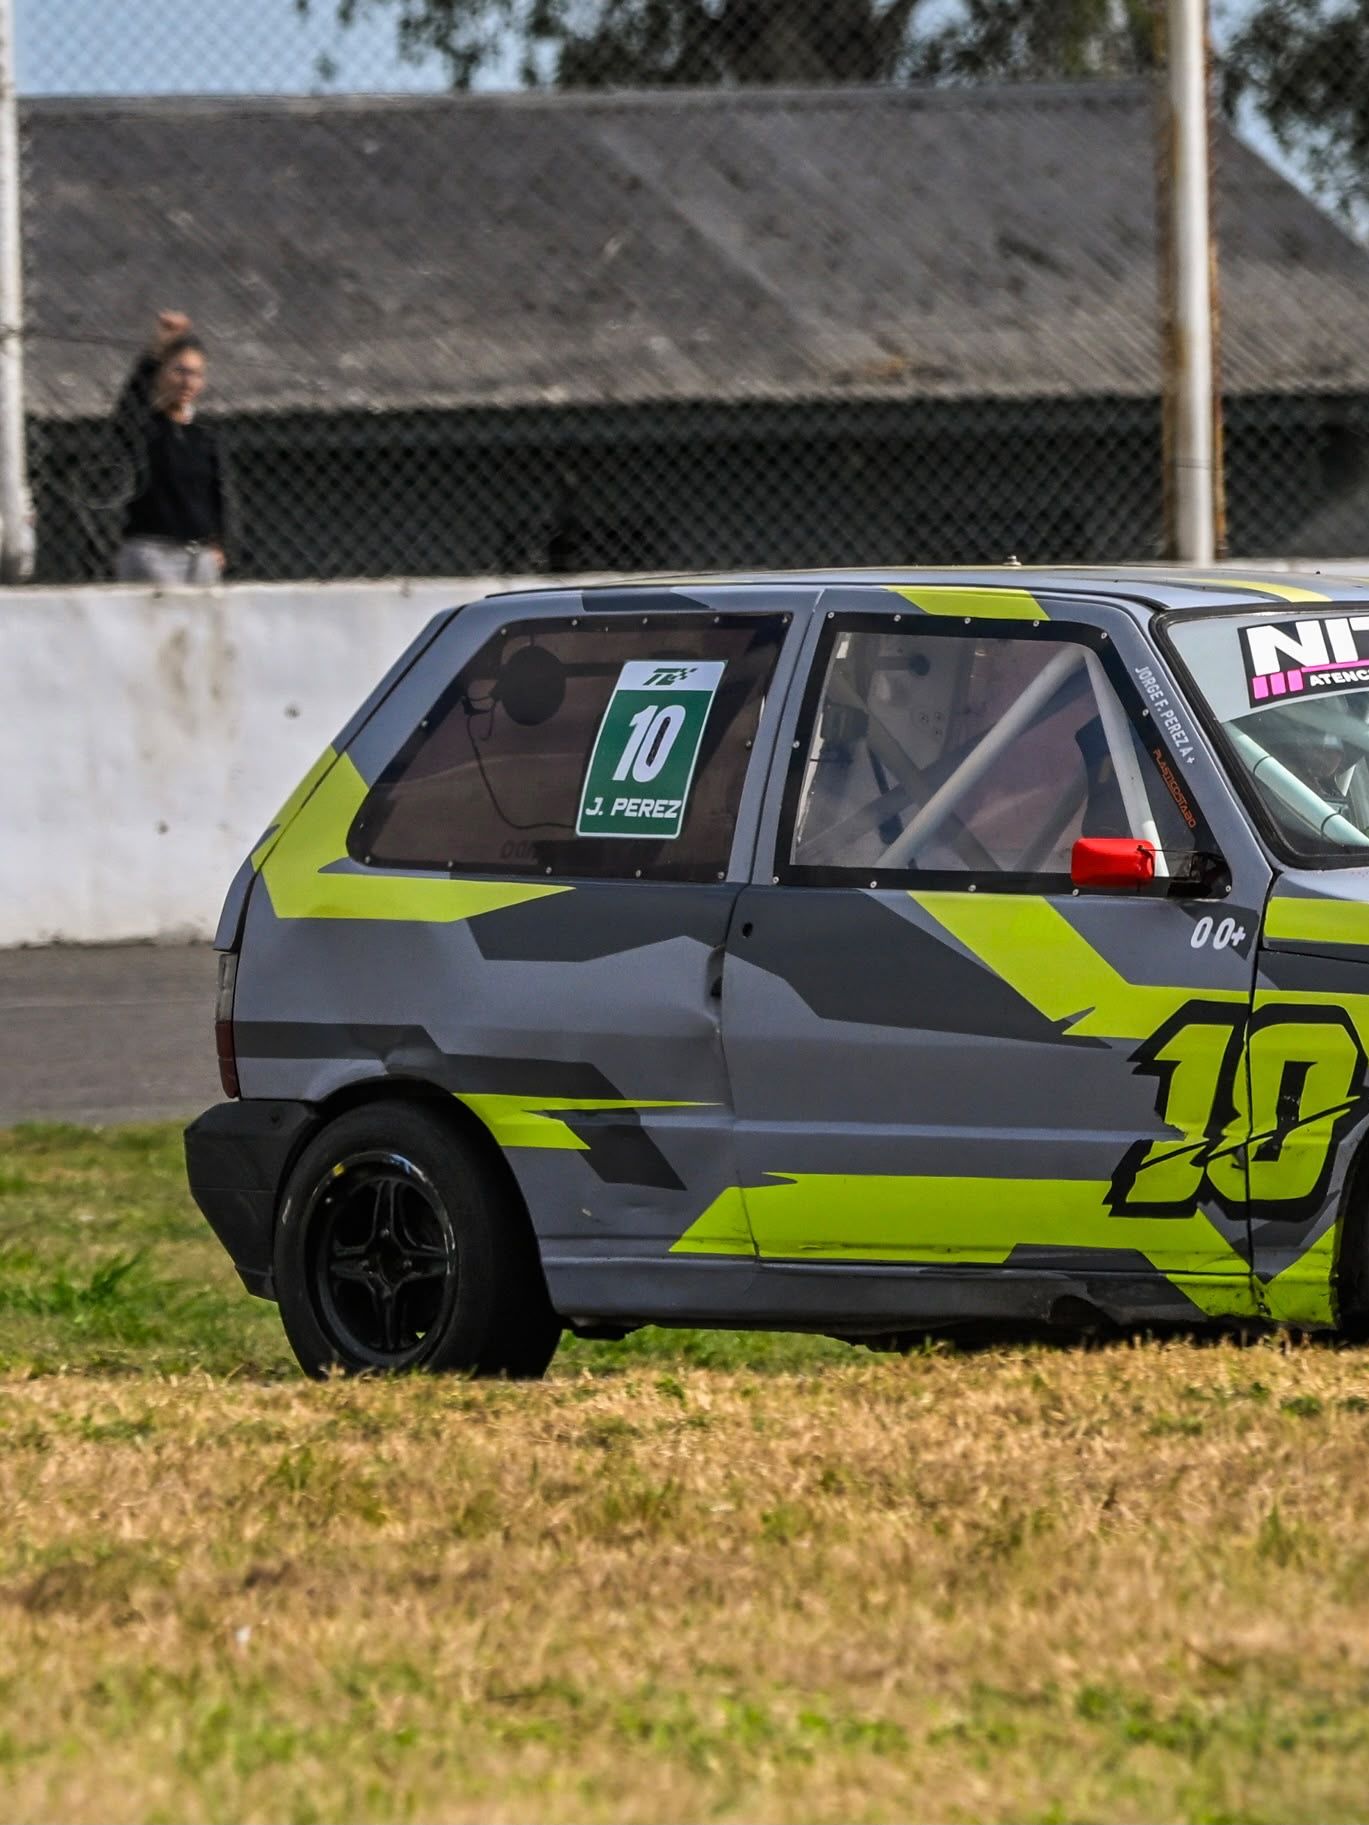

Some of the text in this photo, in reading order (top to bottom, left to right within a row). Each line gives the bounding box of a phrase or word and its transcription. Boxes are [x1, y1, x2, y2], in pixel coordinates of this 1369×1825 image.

[1135, 666, 1164, 701] JORGE
[1154, 698, 1169, 712] F.
[612, 704, 687, 783] 10
[1160, 709, 1190, 748] PEREZ
[585, 796, 683, 819] J. PEREZ
